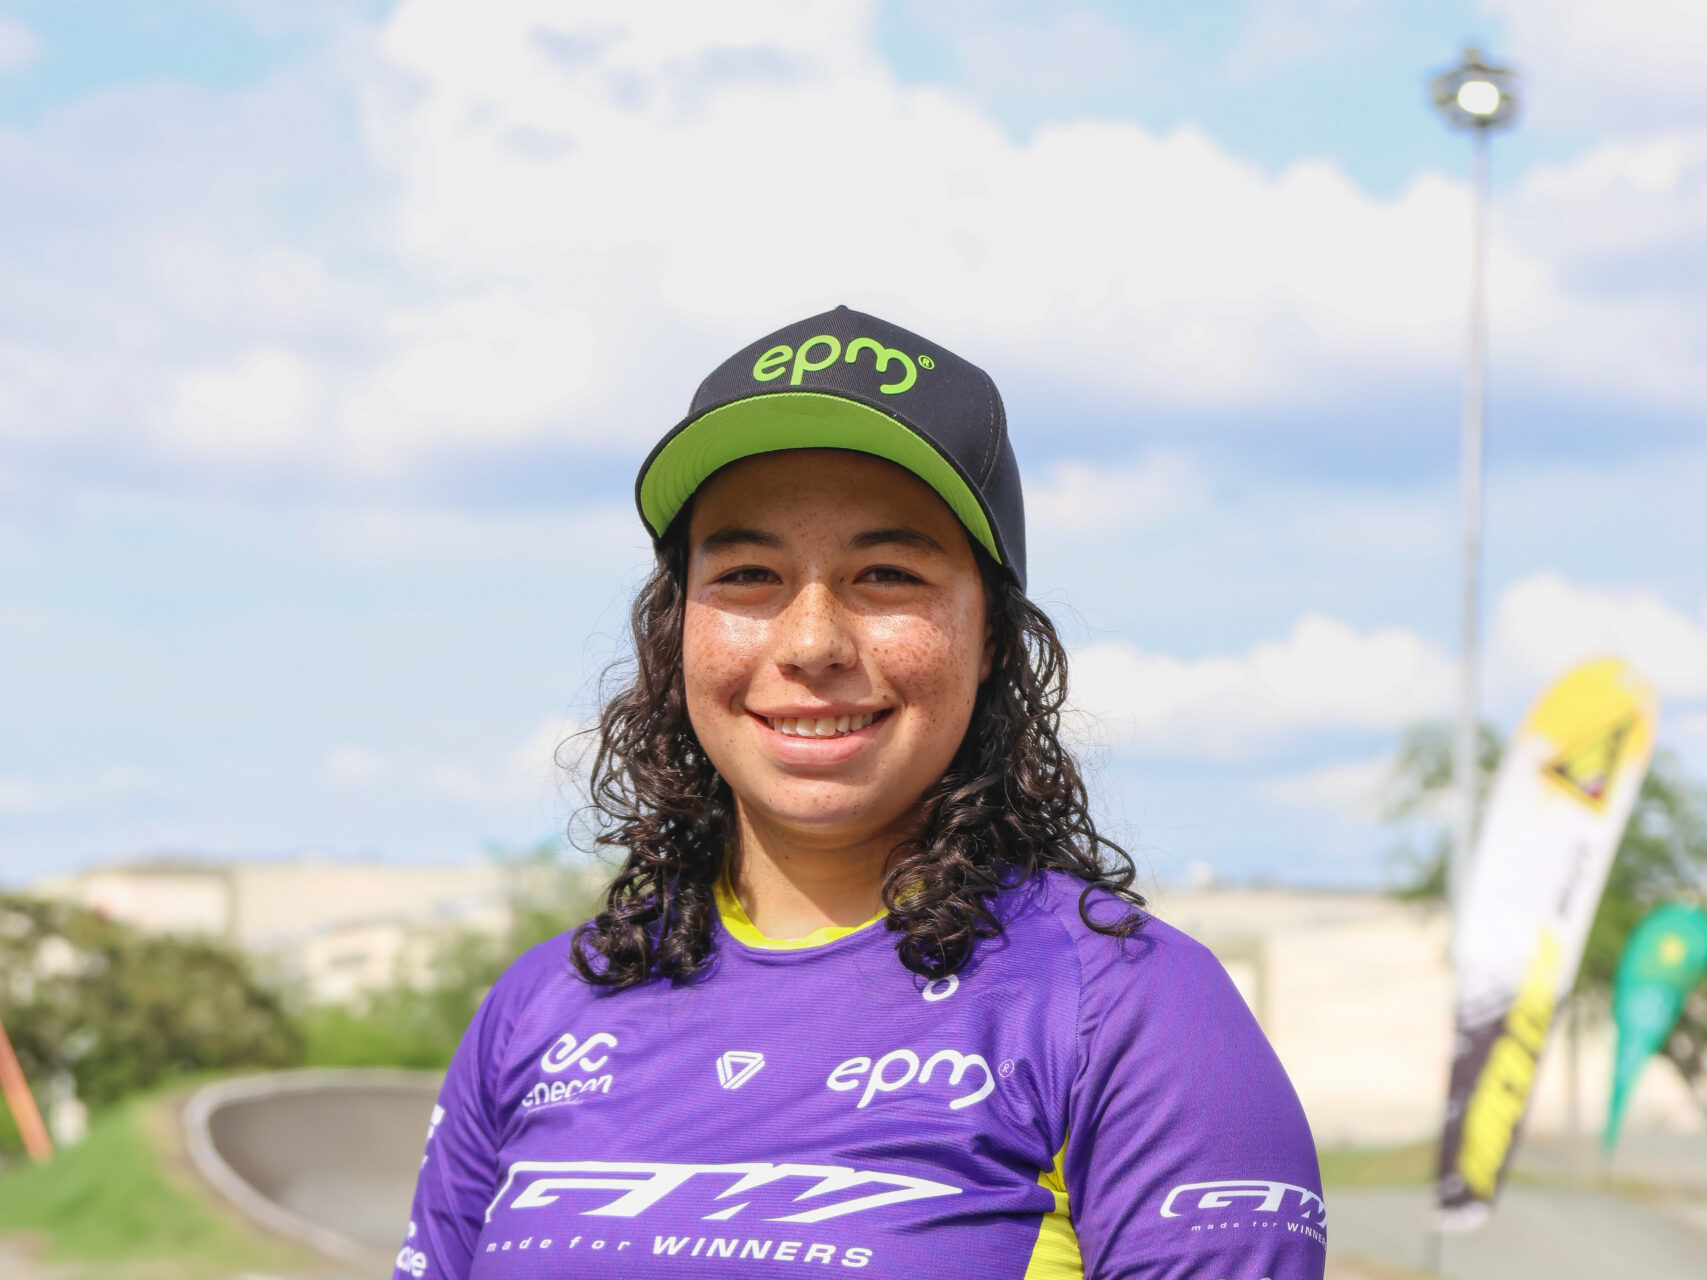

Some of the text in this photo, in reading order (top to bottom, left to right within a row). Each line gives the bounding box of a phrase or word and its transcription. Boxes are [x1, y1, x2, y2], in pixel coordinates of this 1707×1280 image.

[1191, 1221, 1240, 1232] made
[486, 1235, 874, 1268] made for WINNERS
